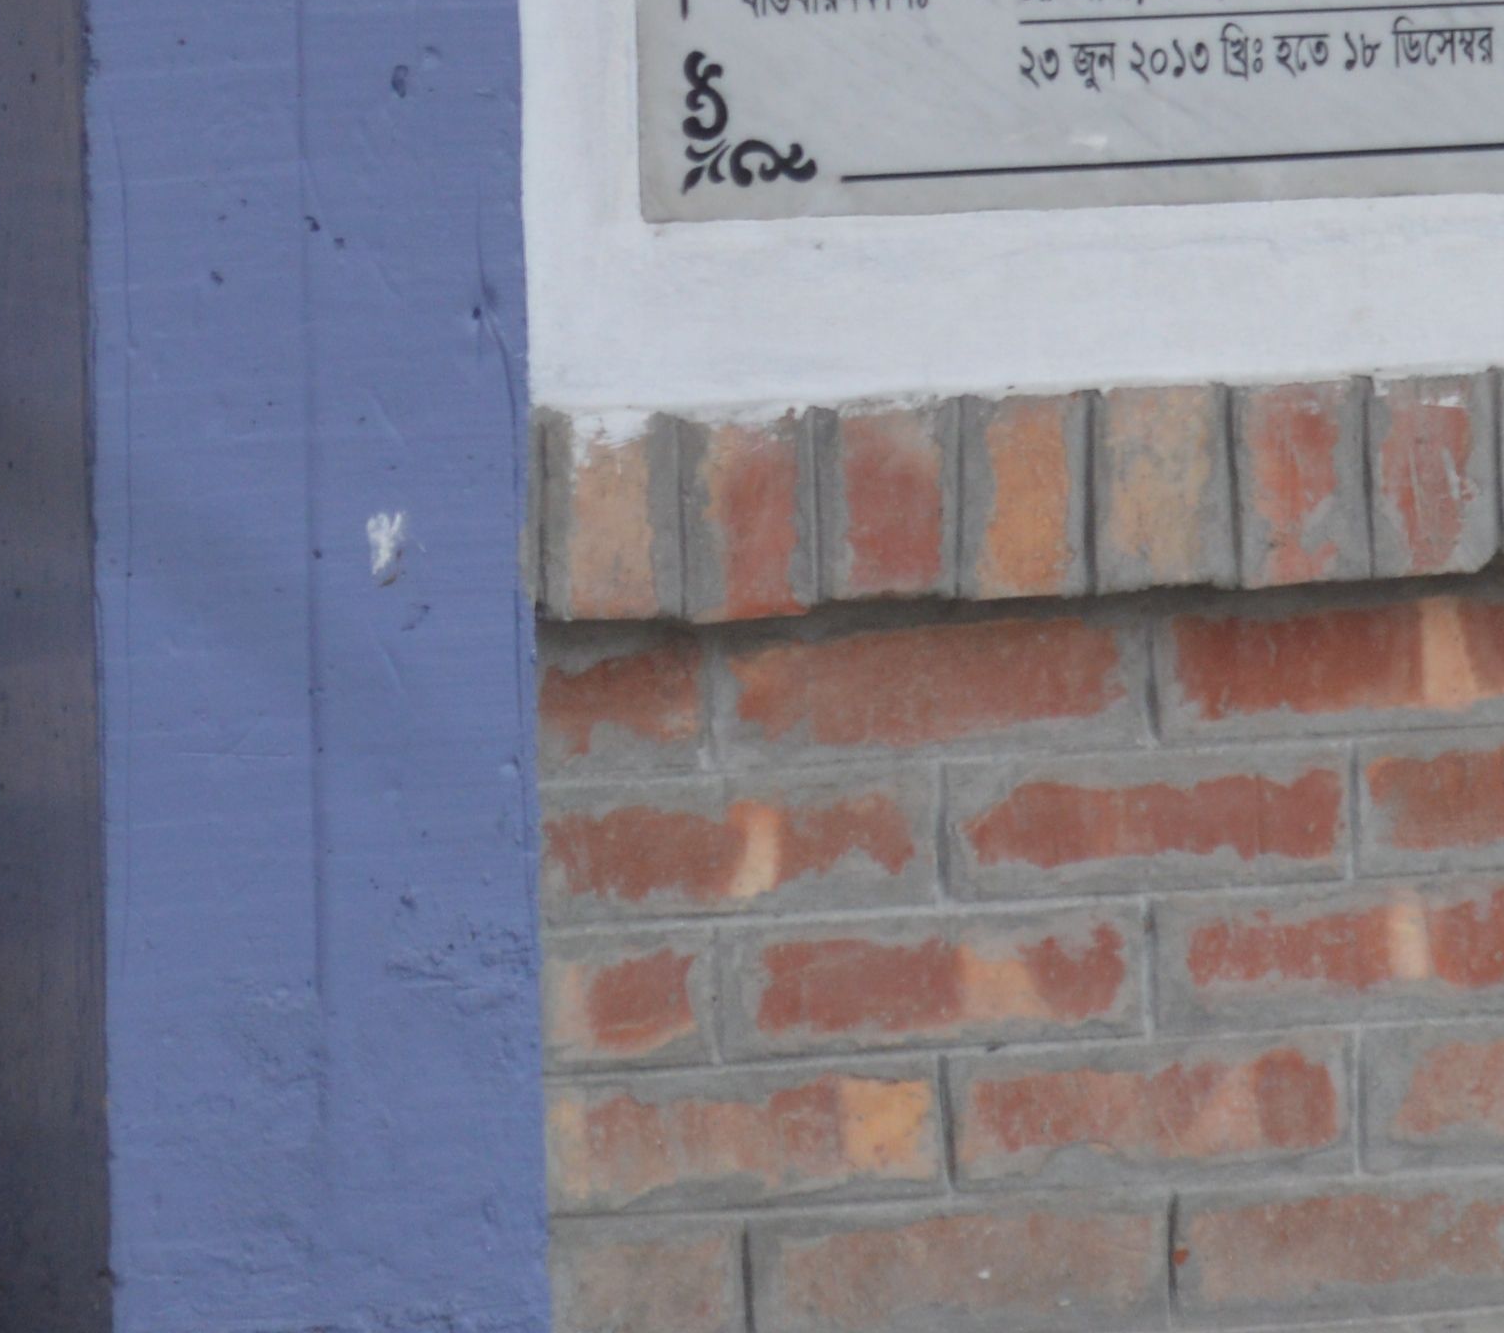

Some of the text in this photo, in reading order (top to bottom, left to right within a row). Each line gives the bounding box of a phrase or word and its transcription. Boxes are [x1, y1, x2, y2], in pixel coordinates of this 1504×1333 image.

[1020, 46, 1059, 87] ২৩
[1069, 42, 1116, 91] জুন
[1130, 39, 1209, 82] ২০১৩
[1273, 33, 1329, 76] হতে
[1344, 32, 1381, 71] ১৮
[1392, 16, 1494, 67] ডিসেম্বর
